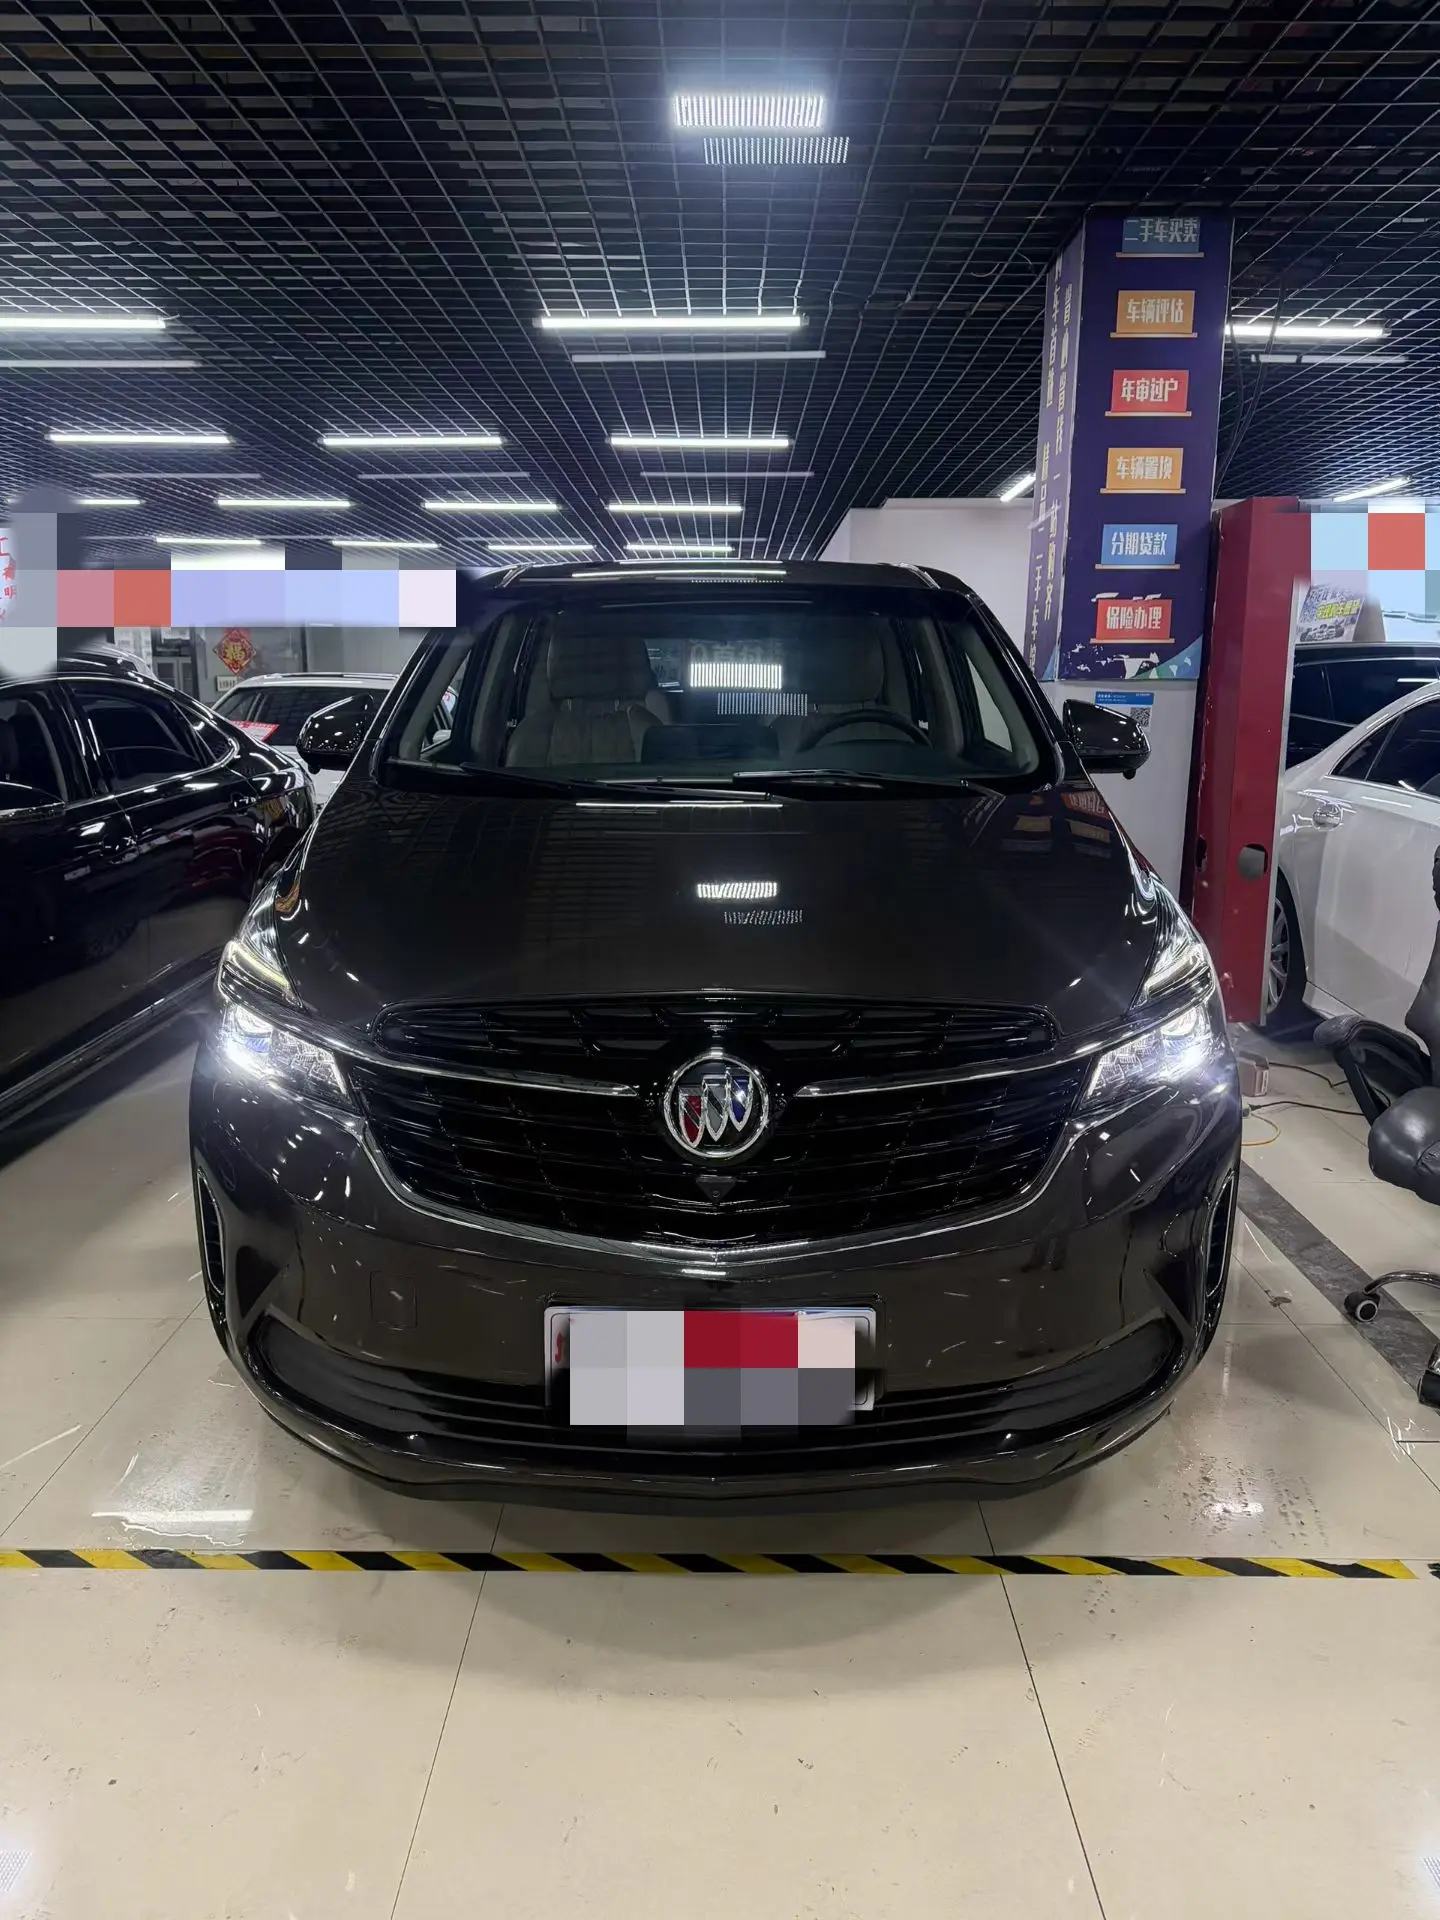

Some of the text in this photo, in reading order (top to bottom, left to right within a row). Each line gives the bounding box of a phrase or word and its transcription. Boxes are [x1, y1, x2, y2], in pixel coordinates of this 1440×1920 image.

[1127, 298, 1184, 323] 车辆评估
[1120, 378, 1178, 402] 年审过户
[1116, 456, 1173, 480] 车辆置换
[1111, 531, 1167, 556] 分期贷款
[1106, 606, 1162, 630] 保险办理
